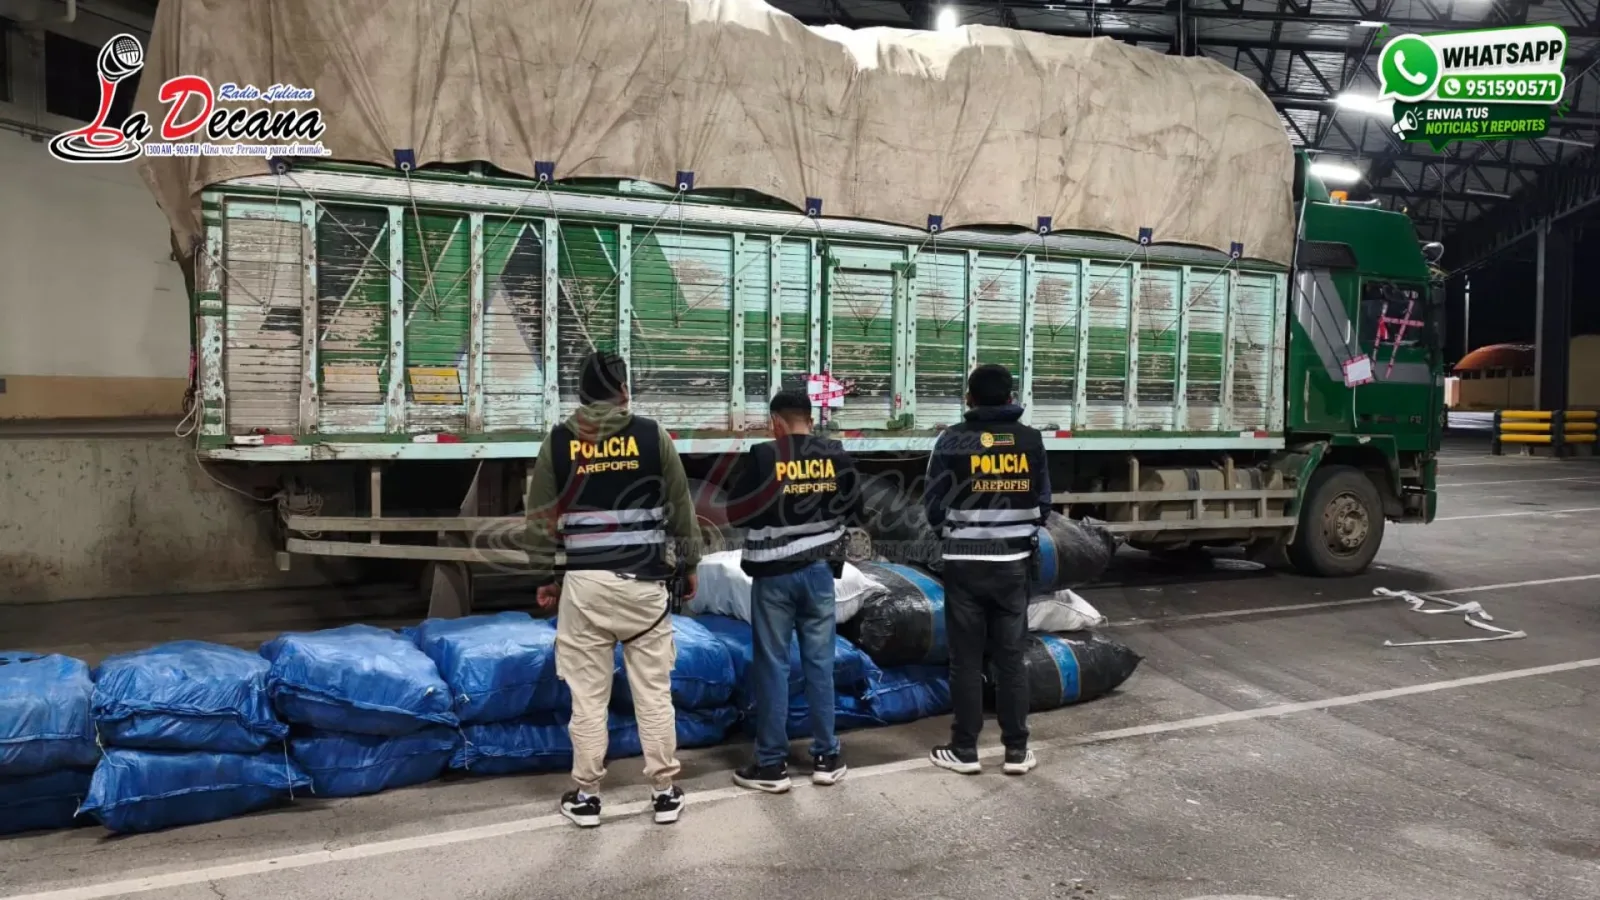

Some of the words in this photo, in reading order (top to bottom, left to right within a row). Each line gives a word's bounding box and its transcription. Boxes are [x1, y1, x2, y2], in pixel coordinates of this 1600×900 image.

[576, 460, 639, 475] AREPOFIS
[782, 482, 837, 494] AREPOFIS
[974, 480, 1028, 490] AREPOFIS
